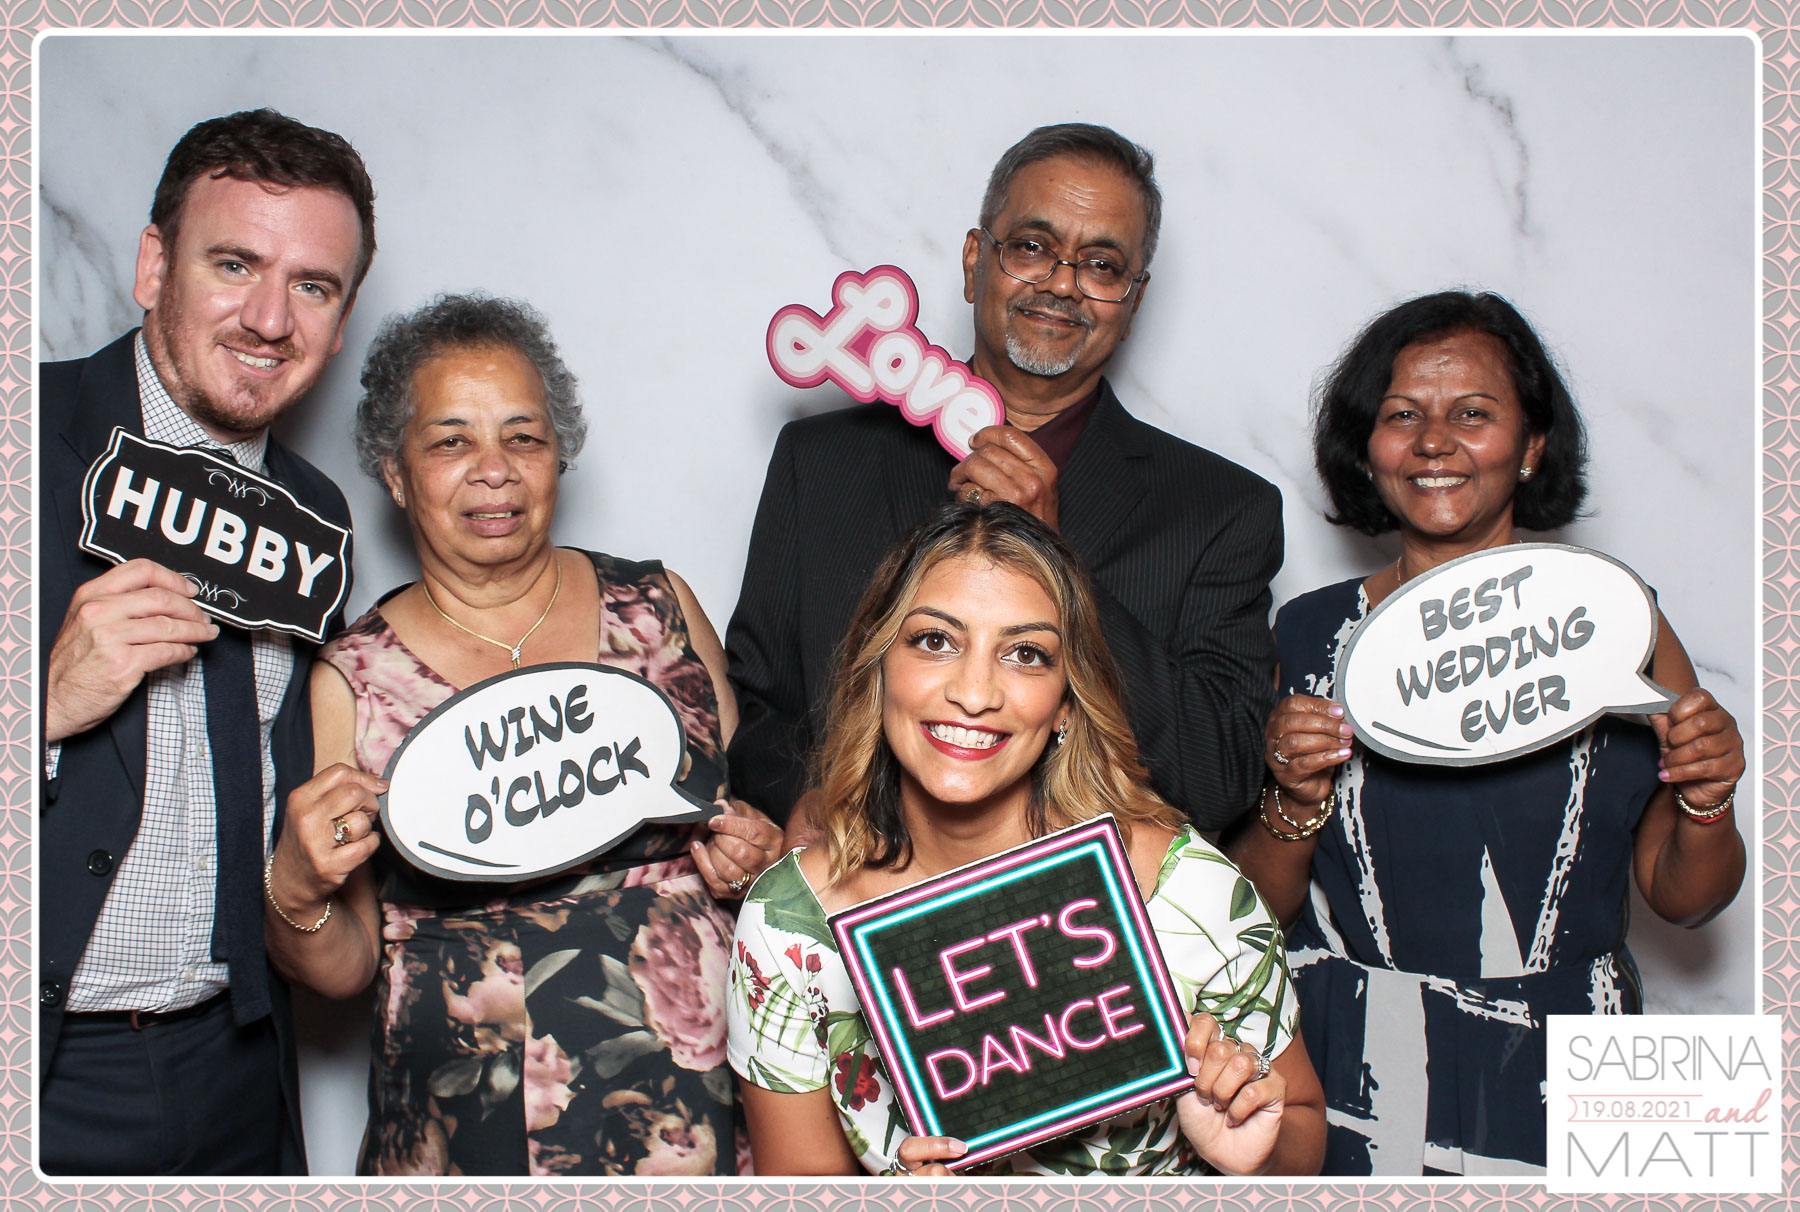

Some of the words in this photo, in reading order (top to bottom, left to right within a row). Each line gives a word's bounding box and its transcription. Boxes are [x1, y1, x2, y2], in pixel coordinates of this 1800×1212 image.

[772, 275, 996, 455] Love
[106, 465, 335, 598] HUBBY
[1396, 606, 1595, 706] WEDDING
[1420, 565, 1533, 641] BEST
[465, 684, 594, 770] WINE
[1460, 674, 1570, 742] EVER
[465, 736, 650, 844] O'CLOCK
[892, 899, 1117, 1029] LET'S
[925, 984, 1145, 1100] DANCE
